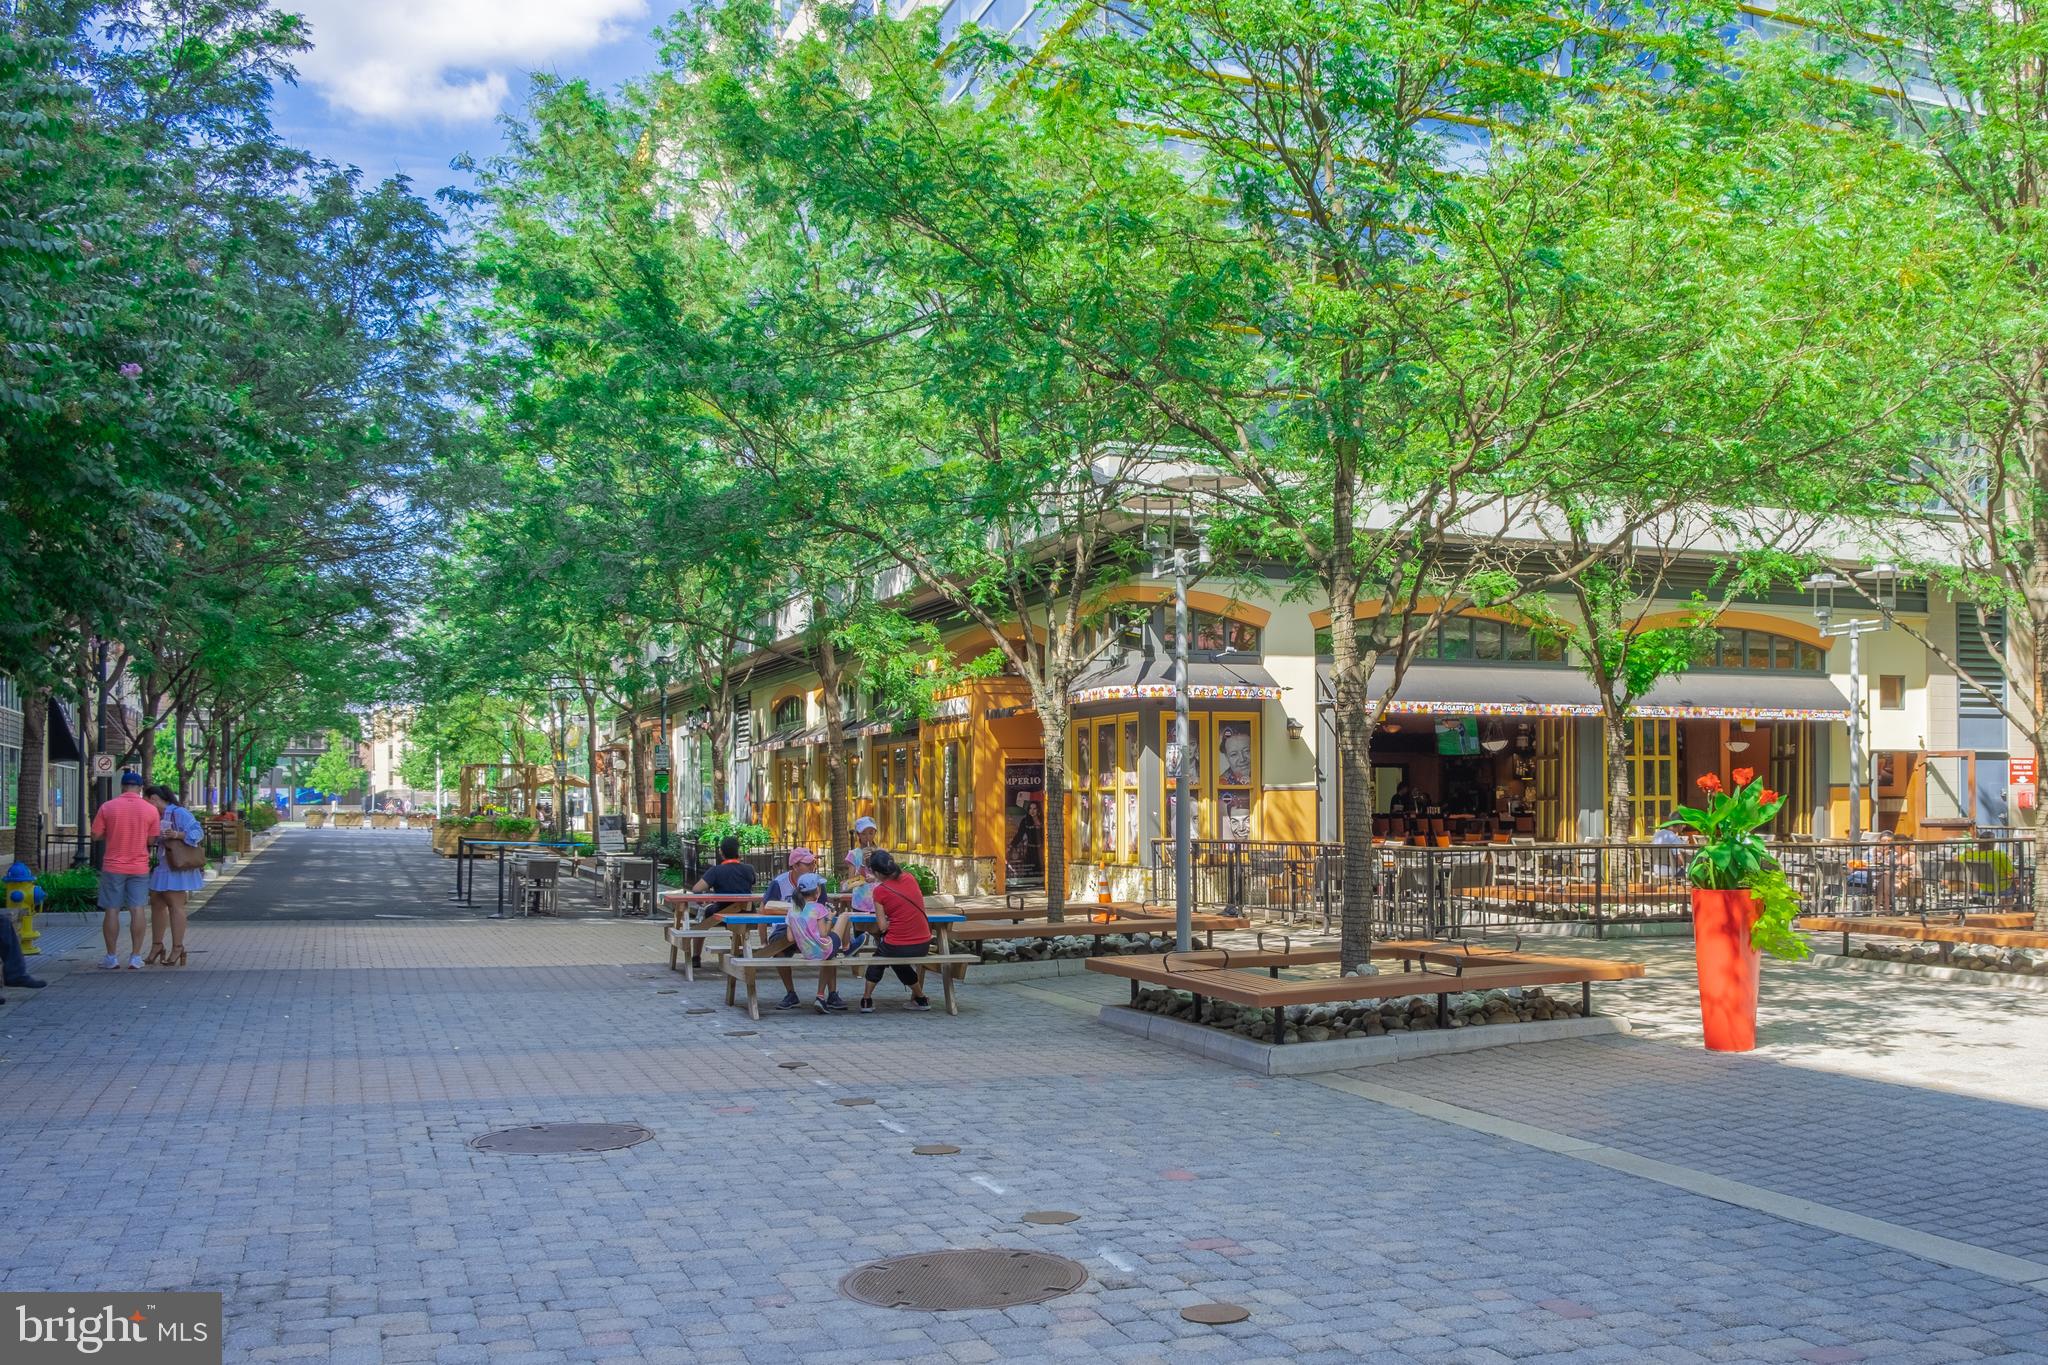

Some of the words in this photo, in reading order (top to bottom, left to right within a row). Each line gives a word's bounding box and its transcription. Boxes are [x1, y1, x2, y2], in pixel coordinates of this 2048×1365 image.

[1186, 688, 1217, 697] LAZA
[1222, 688, 1273, 697] OAXACA
[1433, 702, 1473, 712] MARGARITAS
[1503, 704, 1523, 712] TACOS
[1568, 706, 1599, 714] TLAYUDAS
[1639, 707, 1665, 715] CERVEZA
[1708, 709, 1724, 717] MOLE
